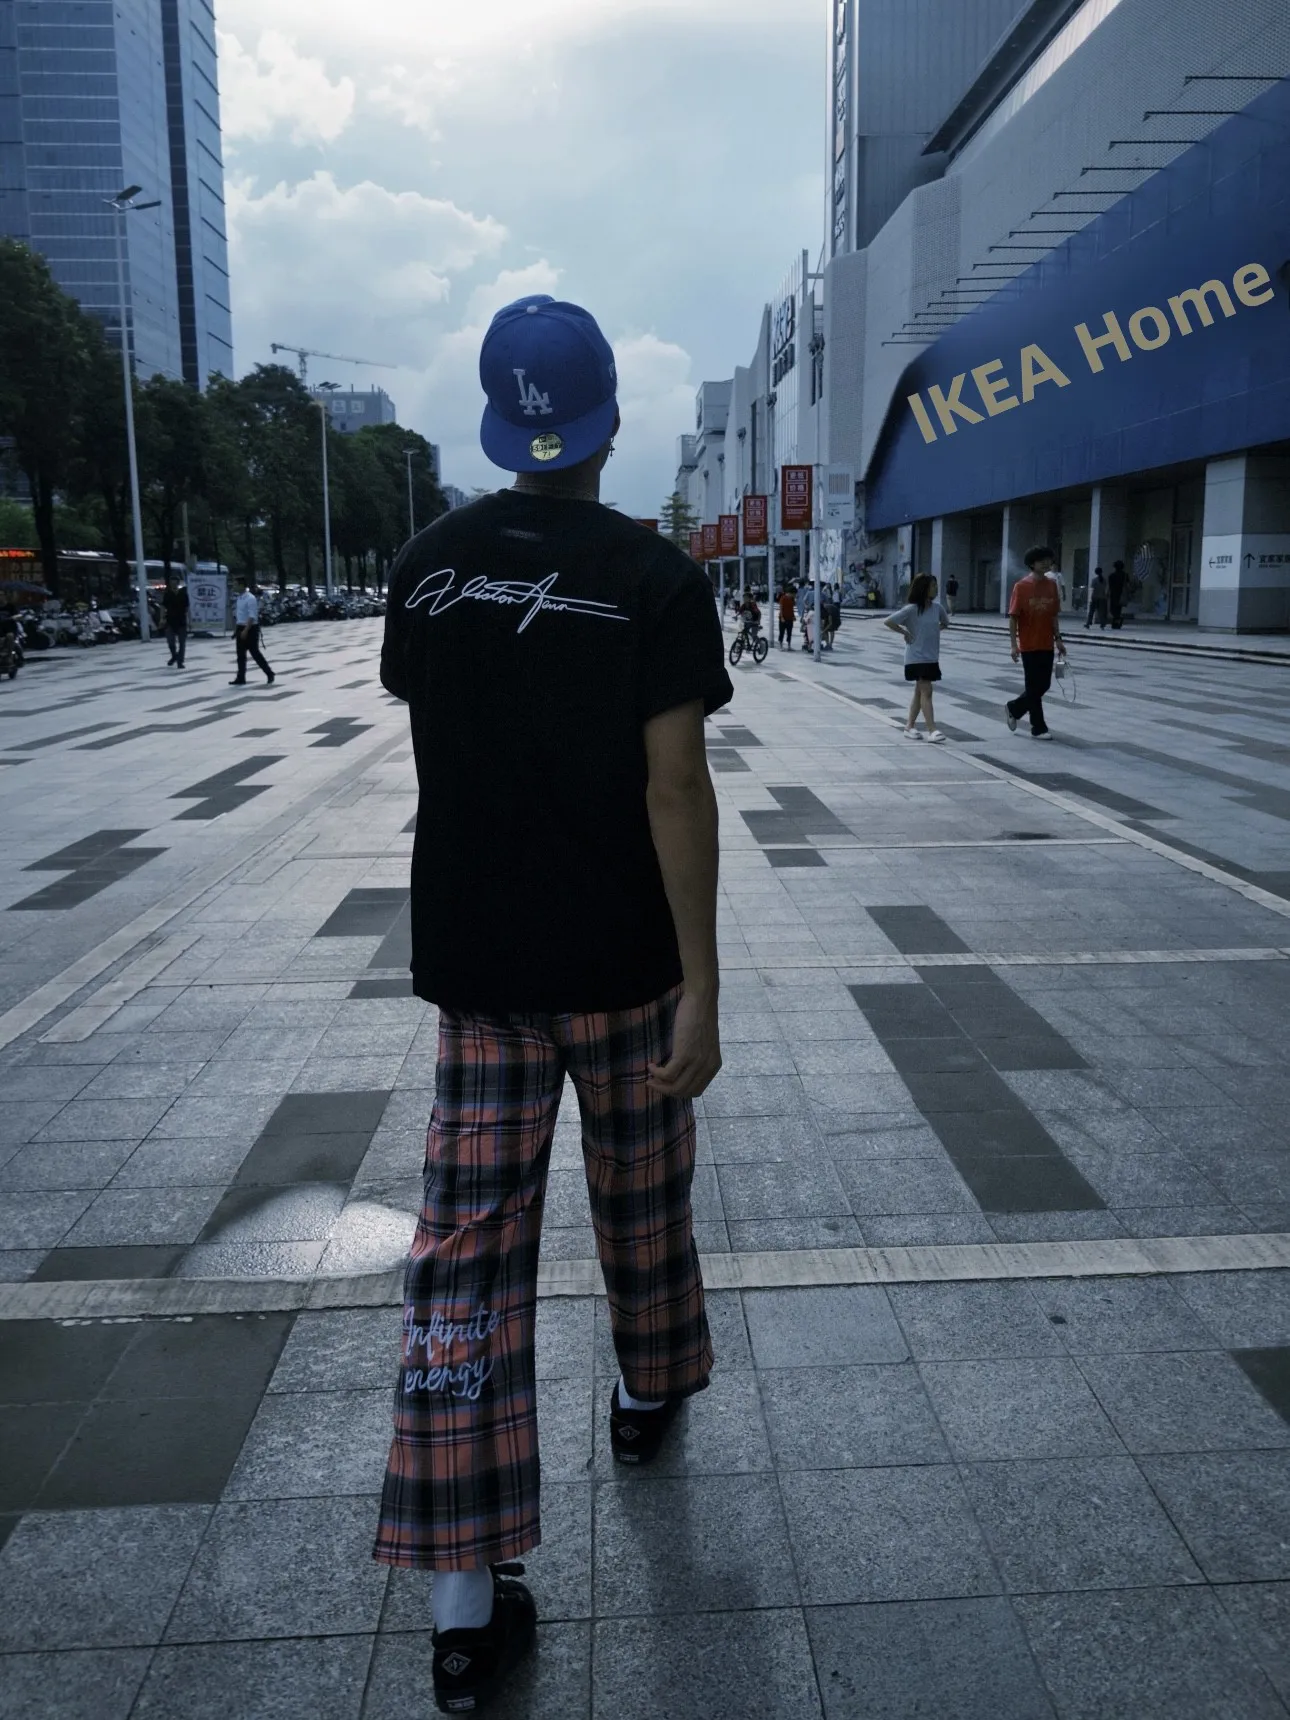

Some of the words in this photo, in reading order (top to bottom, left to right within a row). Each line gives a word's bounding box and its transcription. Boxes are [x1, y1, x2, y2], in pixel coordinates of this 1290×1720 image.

[907, 343, 1071, 444] IKEA
[1074, 262, 1275, 374] Home
[513, 368, 553, 416] LA
[404, 1303, 500, 1361] Infinite
[404, 1355, 495, 1400] energy
